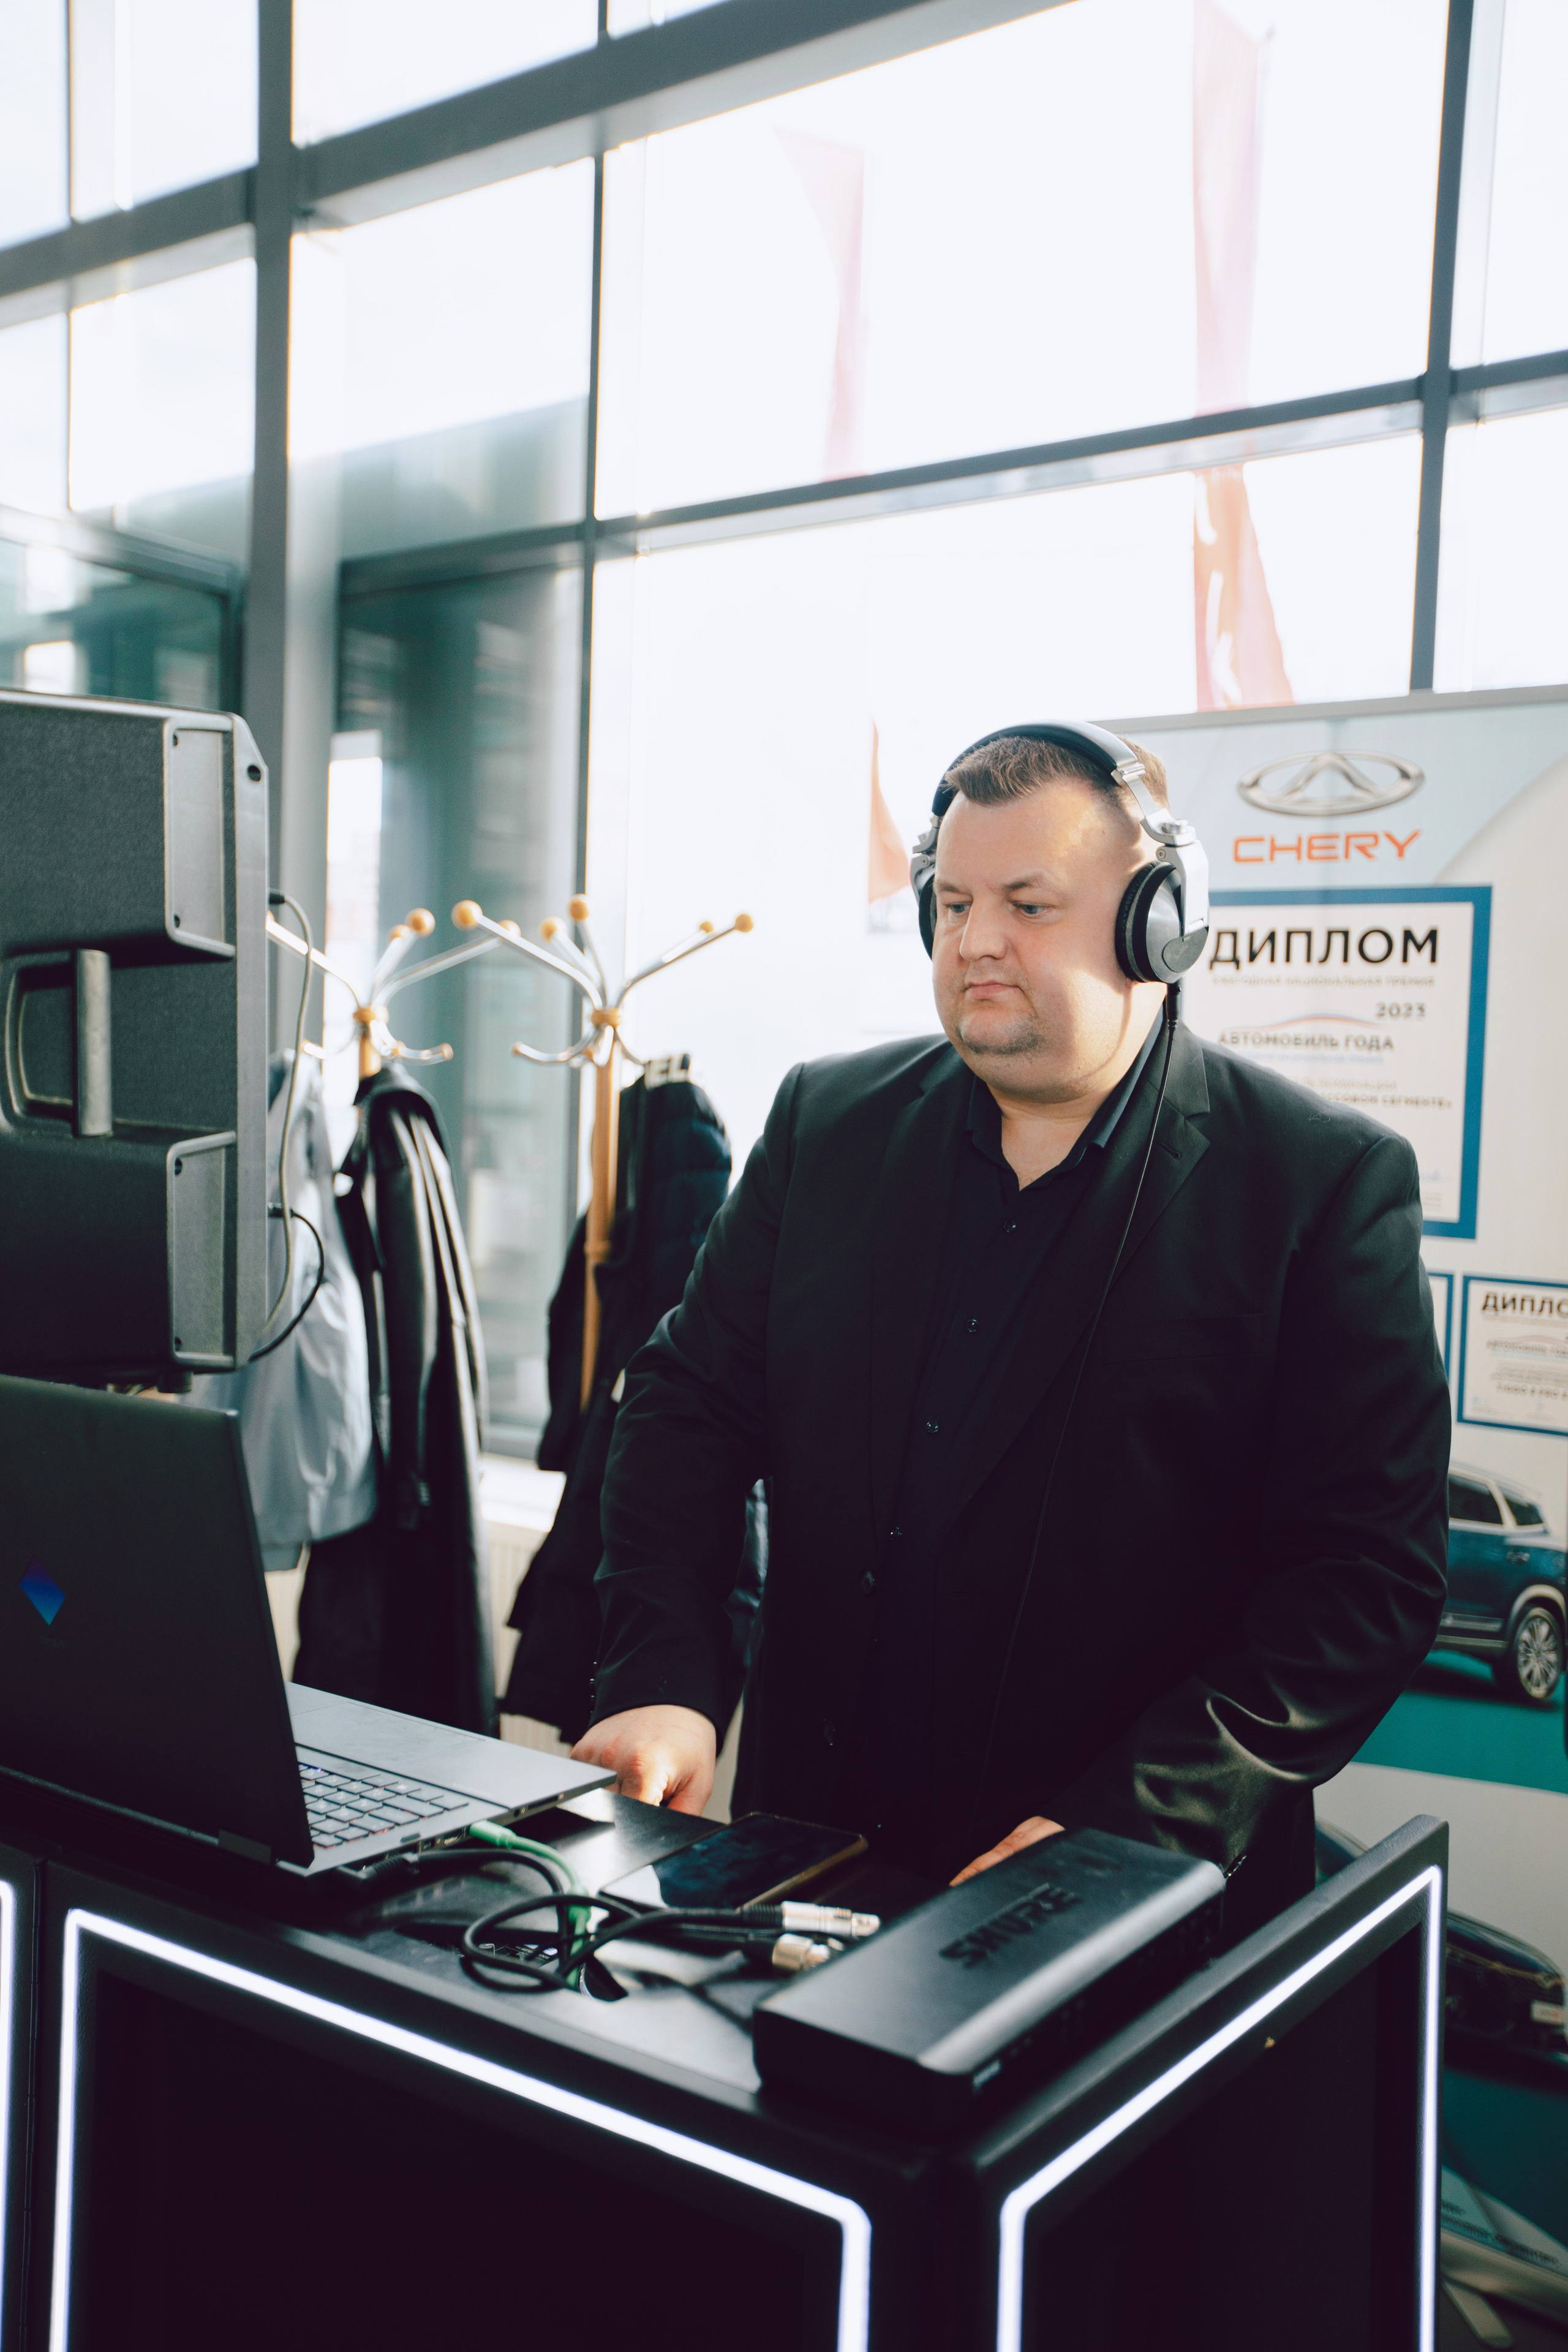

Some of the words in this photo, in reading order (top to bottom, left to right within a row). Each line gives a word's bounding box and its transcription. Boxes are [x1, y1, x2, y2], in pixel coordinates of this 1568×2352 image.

[1233, 830, 1422, 864] CHERY
[1210, 927, 1438, 970] ДИПЛОМ
[1376, 1003, 1427, 1019] 2023
[1218, 1031, 1339, 1049] АВТОМОБИЛЬ
[1344, 1035, 1395, 1052] ГОДА
